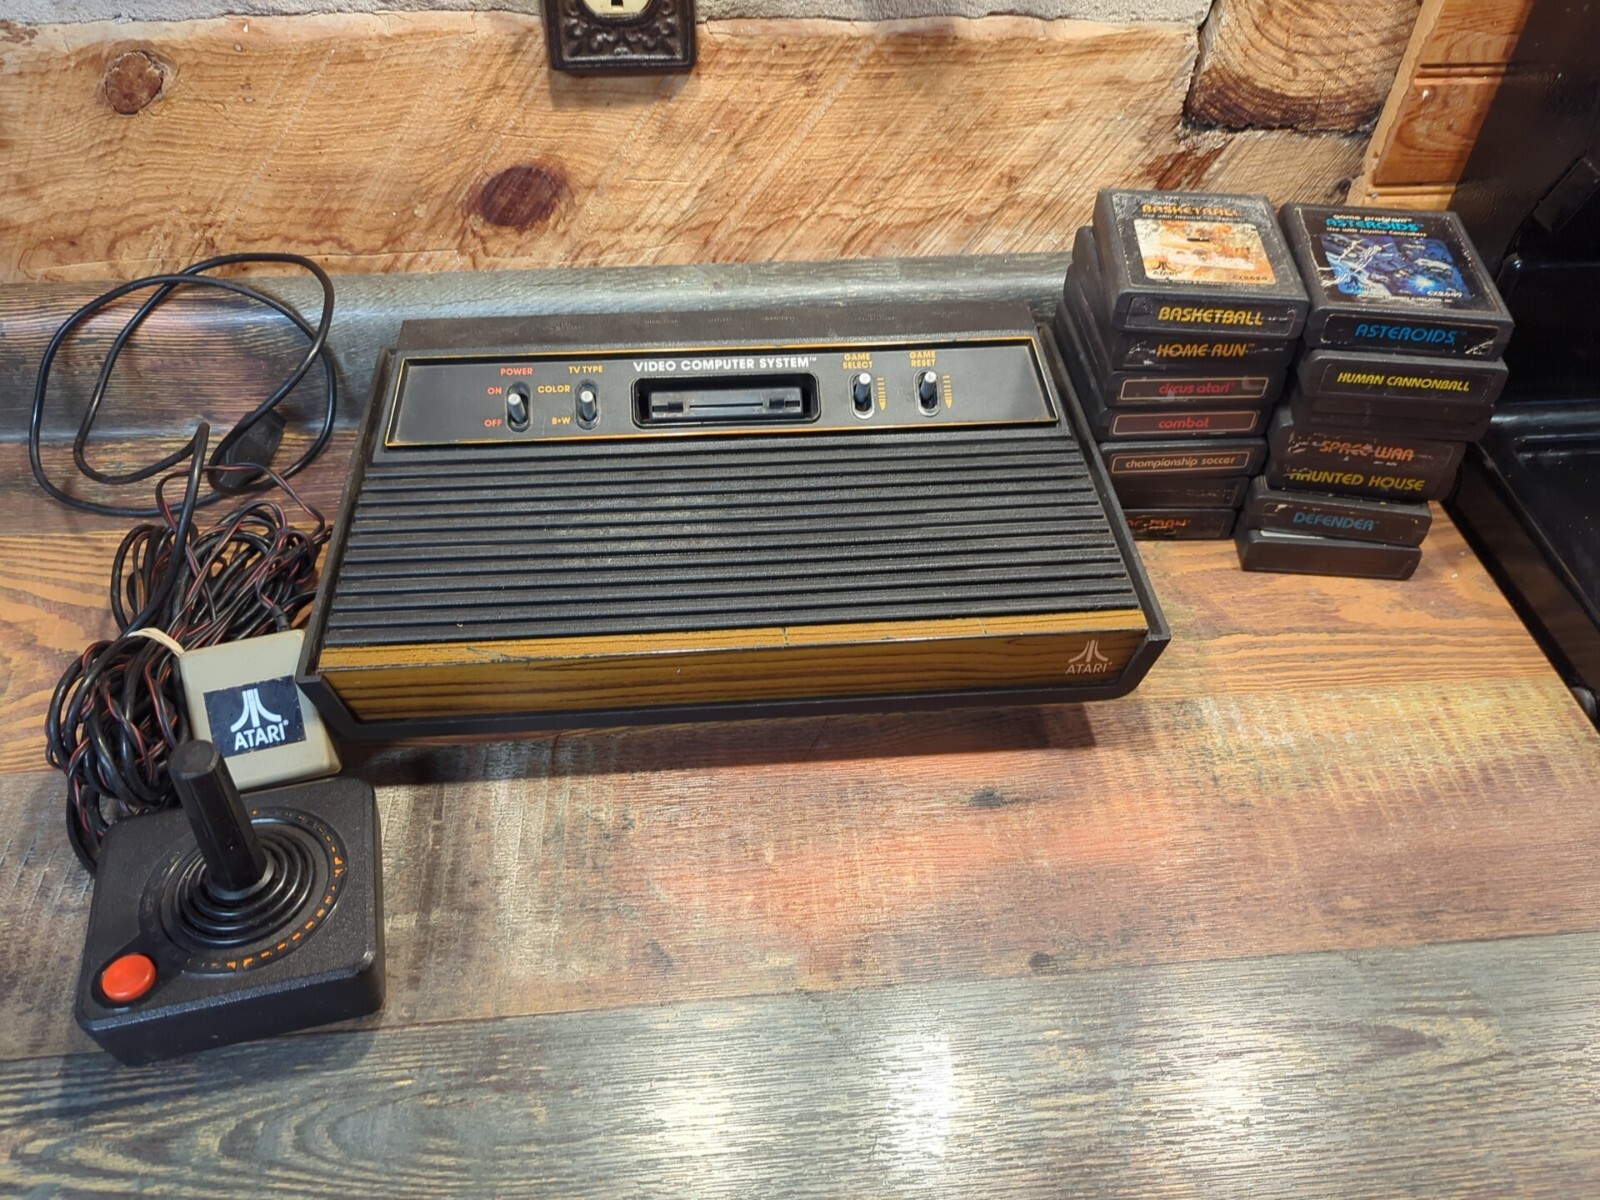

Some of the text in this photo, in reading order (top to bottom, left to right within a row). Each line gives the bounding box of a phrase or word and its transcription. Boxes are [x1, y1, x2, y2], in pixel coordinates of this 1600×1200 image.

[1158, 306, 1263, 326] BASKETBALL
[843, 352, 871, 361] GAME
[909, 350, 937, 359] GAME
[1156, 344, 1208, 358] HOME
[633, 361, 676, 372] VIDEO
[681, 358, 754, 371] COMPUTER
[842, 360, 874, 370] SELECT
[910, 358, 936, 367] RESET
[500, 367, 533, 376] POWER
[568, 365, 603, 374] TV TYPE
[1337, 372, 1470, 392] HUMAN CANNONBALL
[487, 387, 502, 395] ON
[537, 385, 571, 393] COLOR
[1158, 384, 1194, 395] circus
[484, 419, 502, 427] OFF
[1158, 417, 1210, 429] combat
[1374, 446, 1415, 462] WAR
[1125, 456, 1198, 469] championship
[1288, 470, 1426, 491] HAUNTED HOUSE
[1065, 662, 1108, 675] ATARI
[234, 722, 286, 751] ATARI
